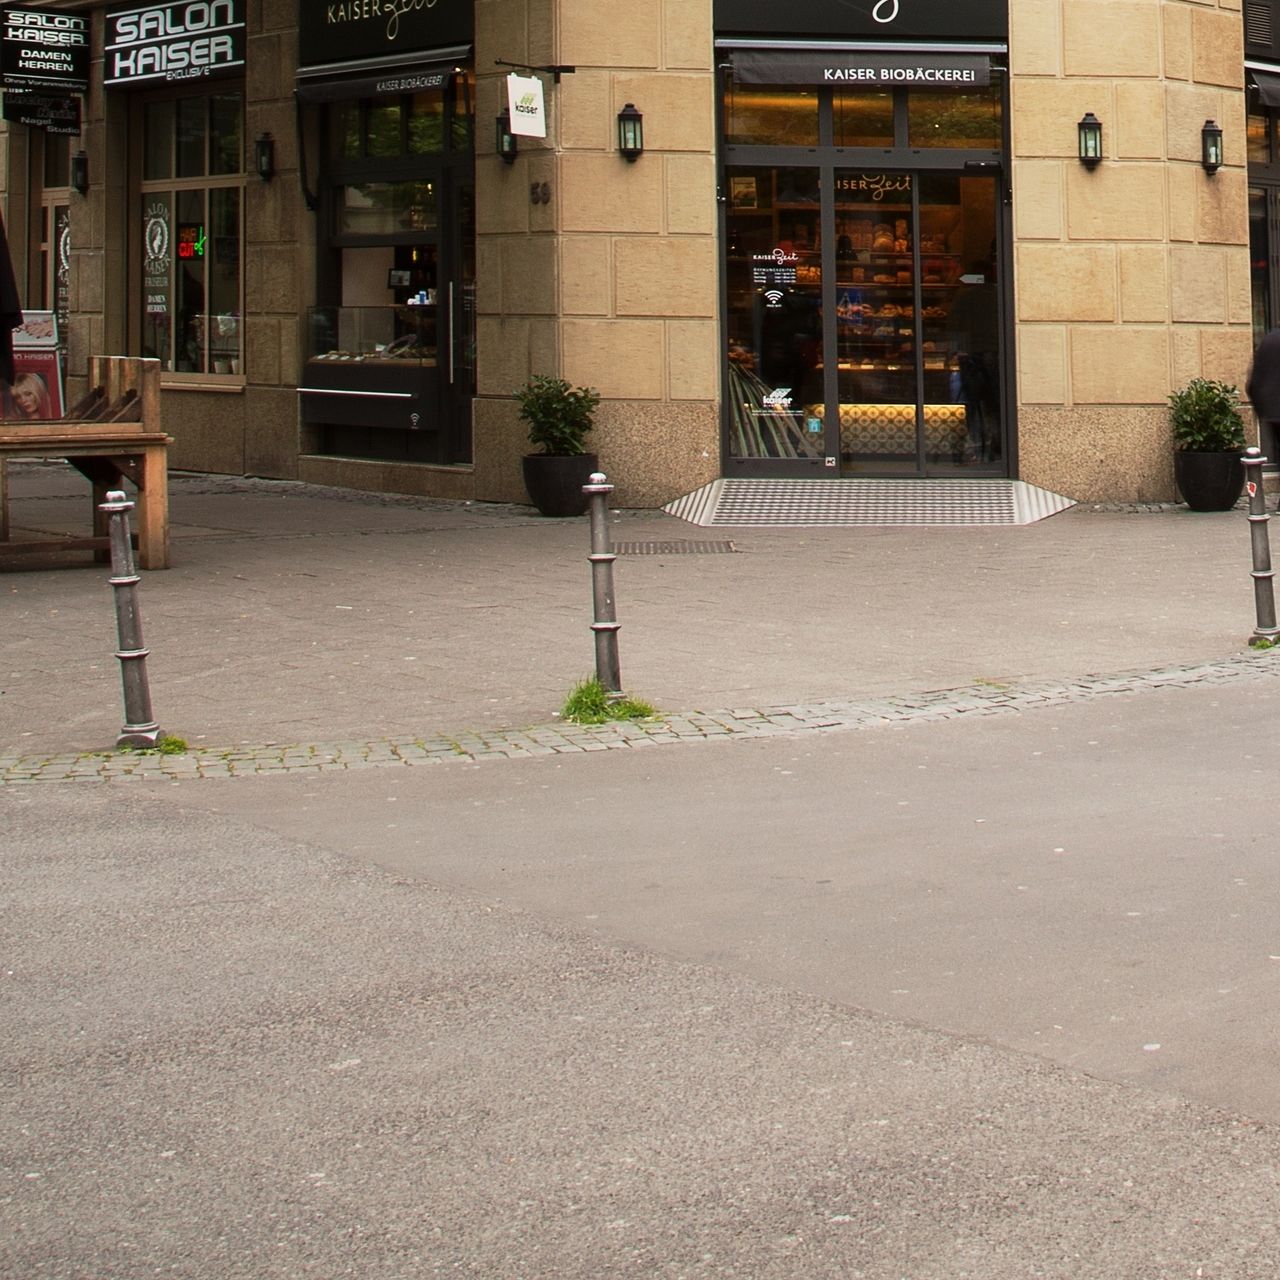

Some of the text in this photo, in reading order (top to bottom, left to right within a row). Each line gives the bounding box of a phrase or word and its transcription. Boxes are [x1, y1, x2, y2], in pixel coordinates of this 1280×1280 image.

[8, 13, 84, 29] SALON
[8, 28, 84, 44] KAISER
[21, 49, 71, 61] DAMEN
[114, 35, 233, 78] KAISER
[19, 60, 73, 71] HERREN
[824, 67, 975, 81] KAISER BIOBÄCKEREI
[28, 80, 87, 90] Voranmeldung
[376, 75, 443, 91] KAISER BIOBÄCKEREI
[515, 101, 538, 114] kaiser
[21, 116, 52, 125] Nagel
[47, 125, 80, 134] Studio
[179, 242, 194, 256] CUT
